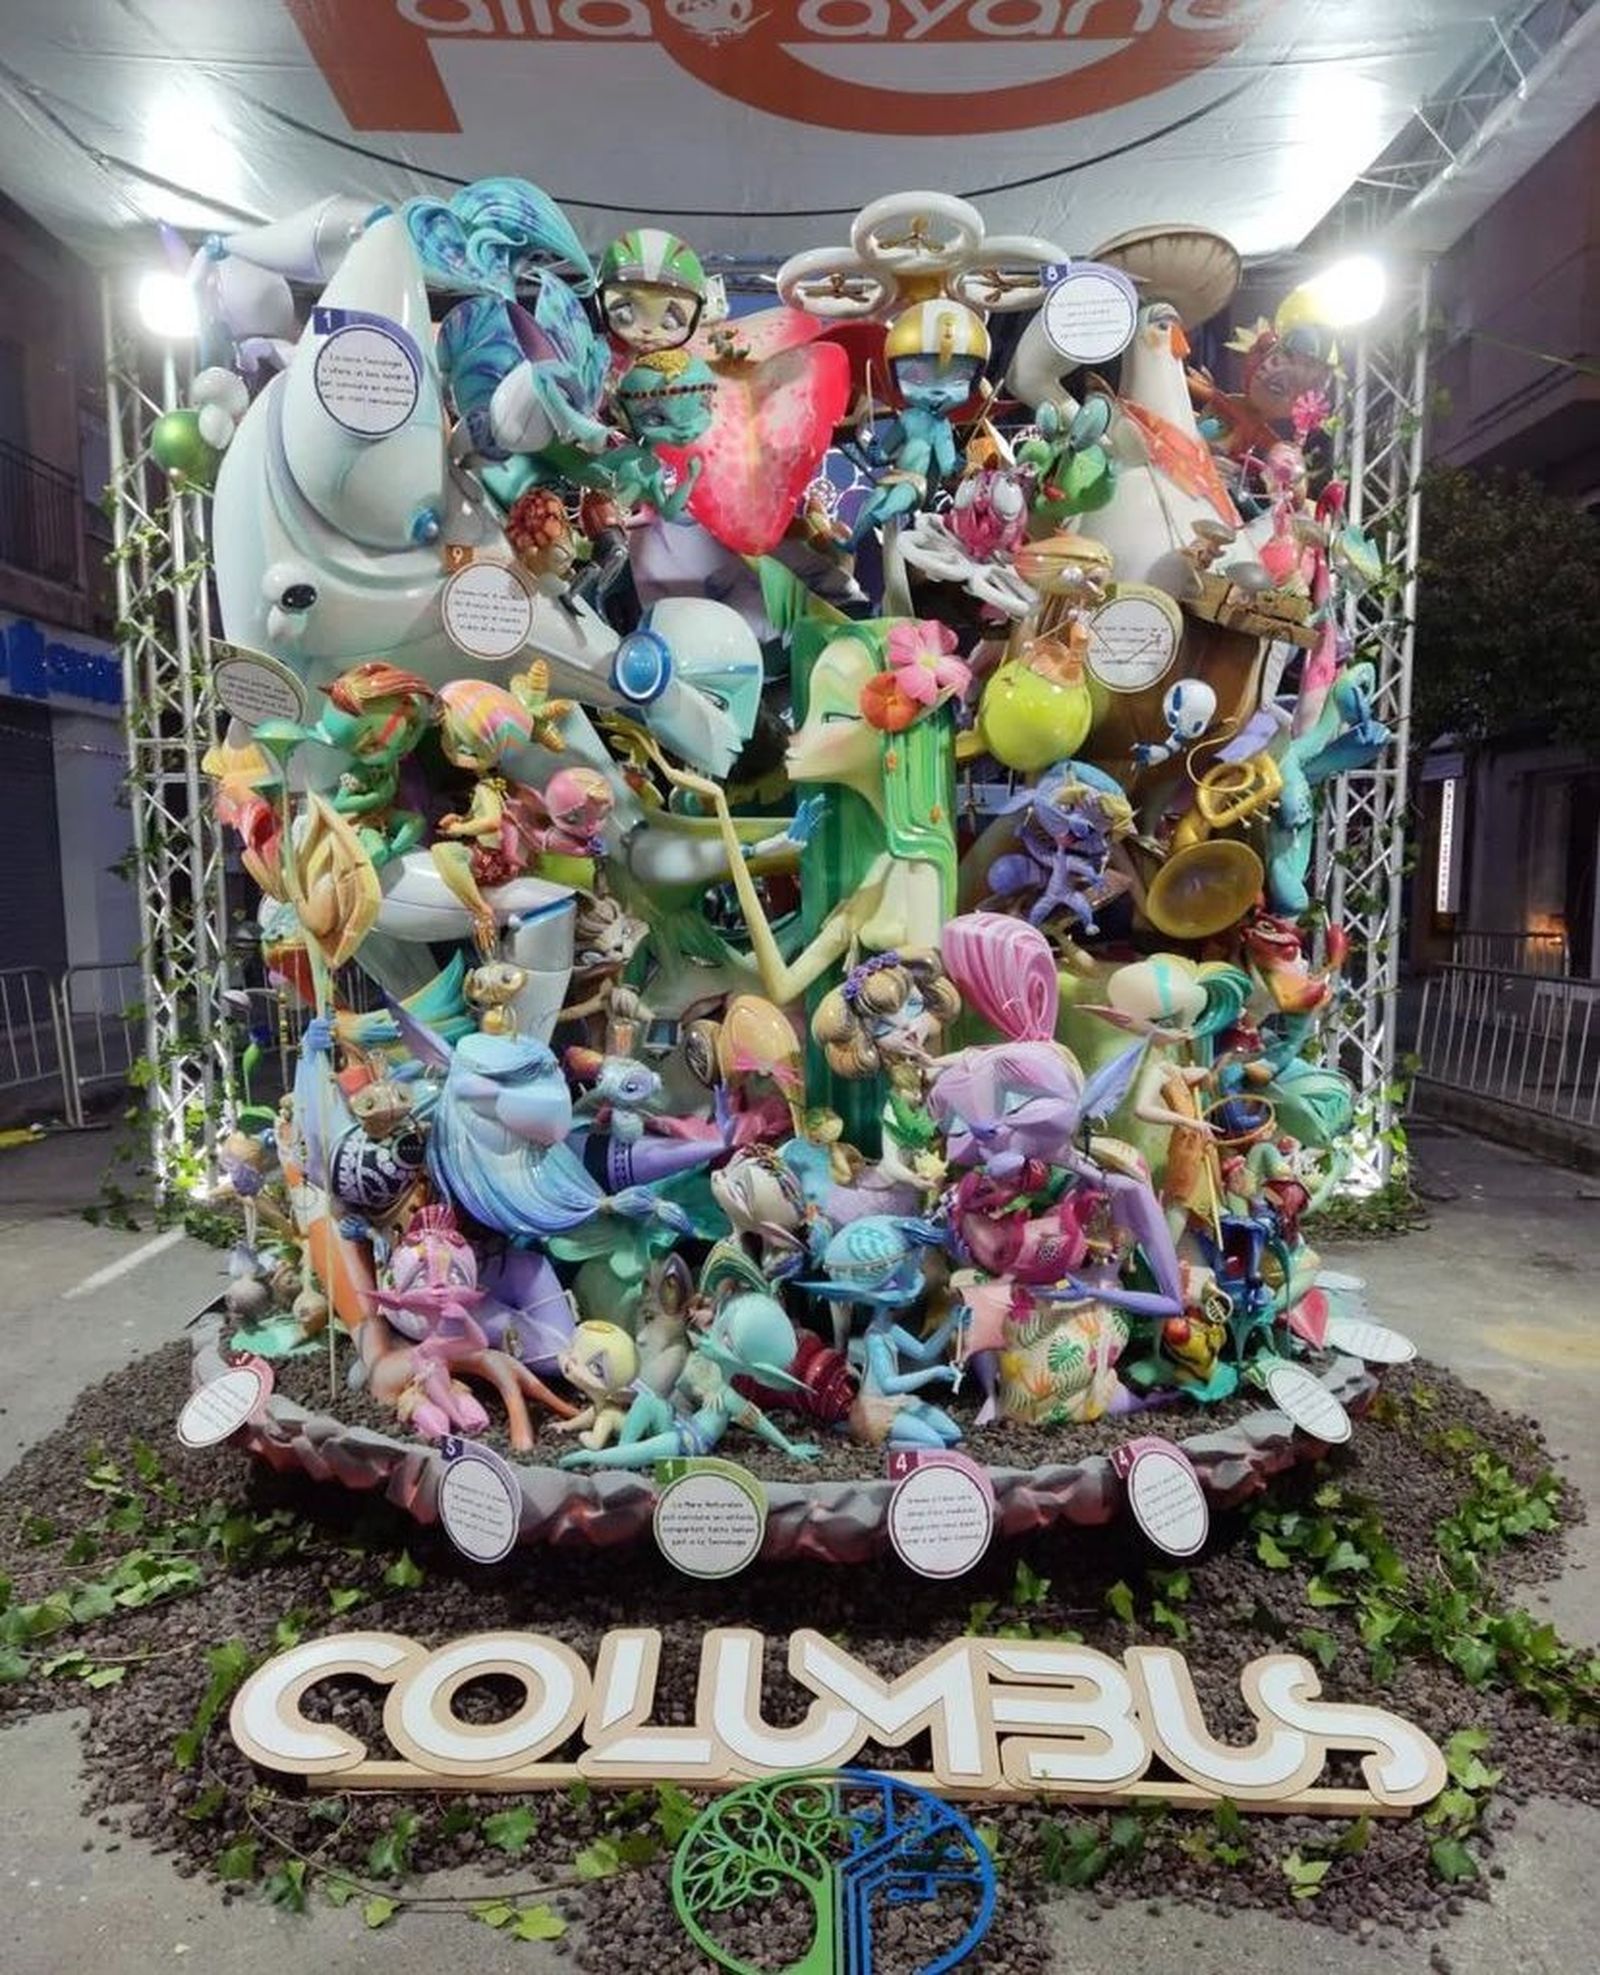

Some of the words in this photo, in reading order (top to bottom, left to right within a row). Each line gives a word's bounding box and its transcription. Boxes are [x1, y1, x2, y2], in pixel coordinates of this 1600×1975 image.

[1046, 265, 1059, 282] 8
[451, 546, 464, 564] 9
[895, 1452, 908, 1473] 4
[233, 1627, 1446, 1804] COLUMBUS
